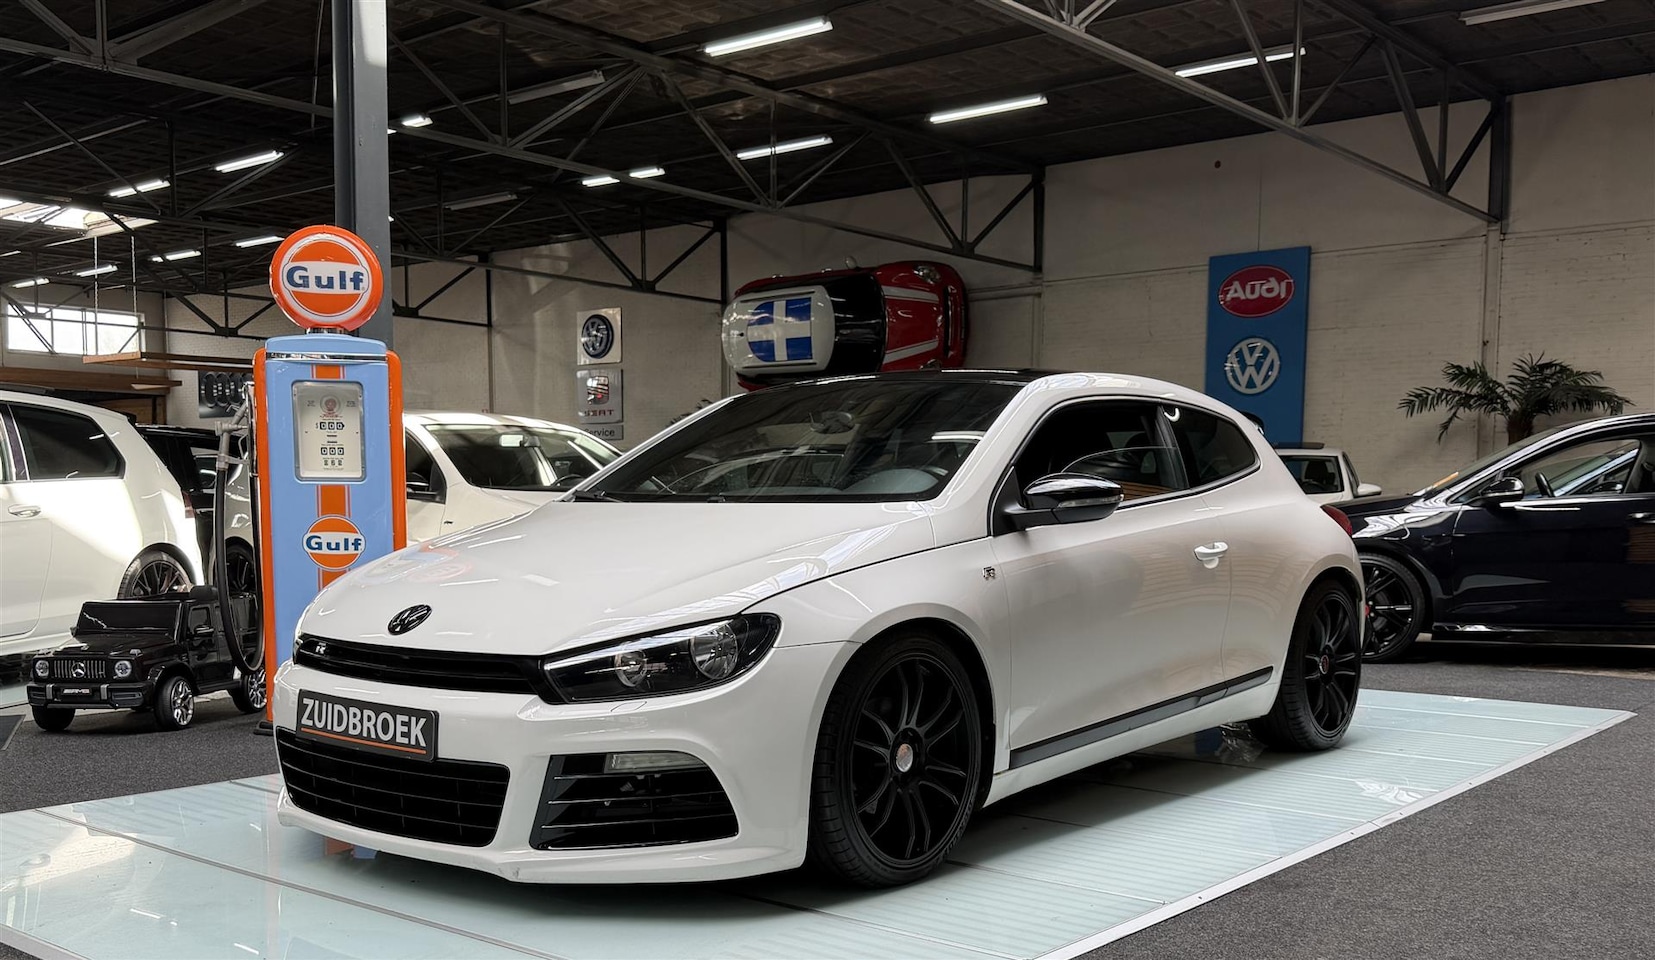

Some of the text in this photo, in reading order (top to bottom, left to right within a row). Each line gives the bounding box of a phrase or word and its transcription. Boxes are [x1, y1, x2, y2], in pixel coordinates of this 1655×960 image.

[286, 265, 364, 291] Gulf
[1226, 277, 1290, 301] Audi
[305, 535, 362, 551] Gulf
[301, 698, 427, 747] ZUIDBROEK
